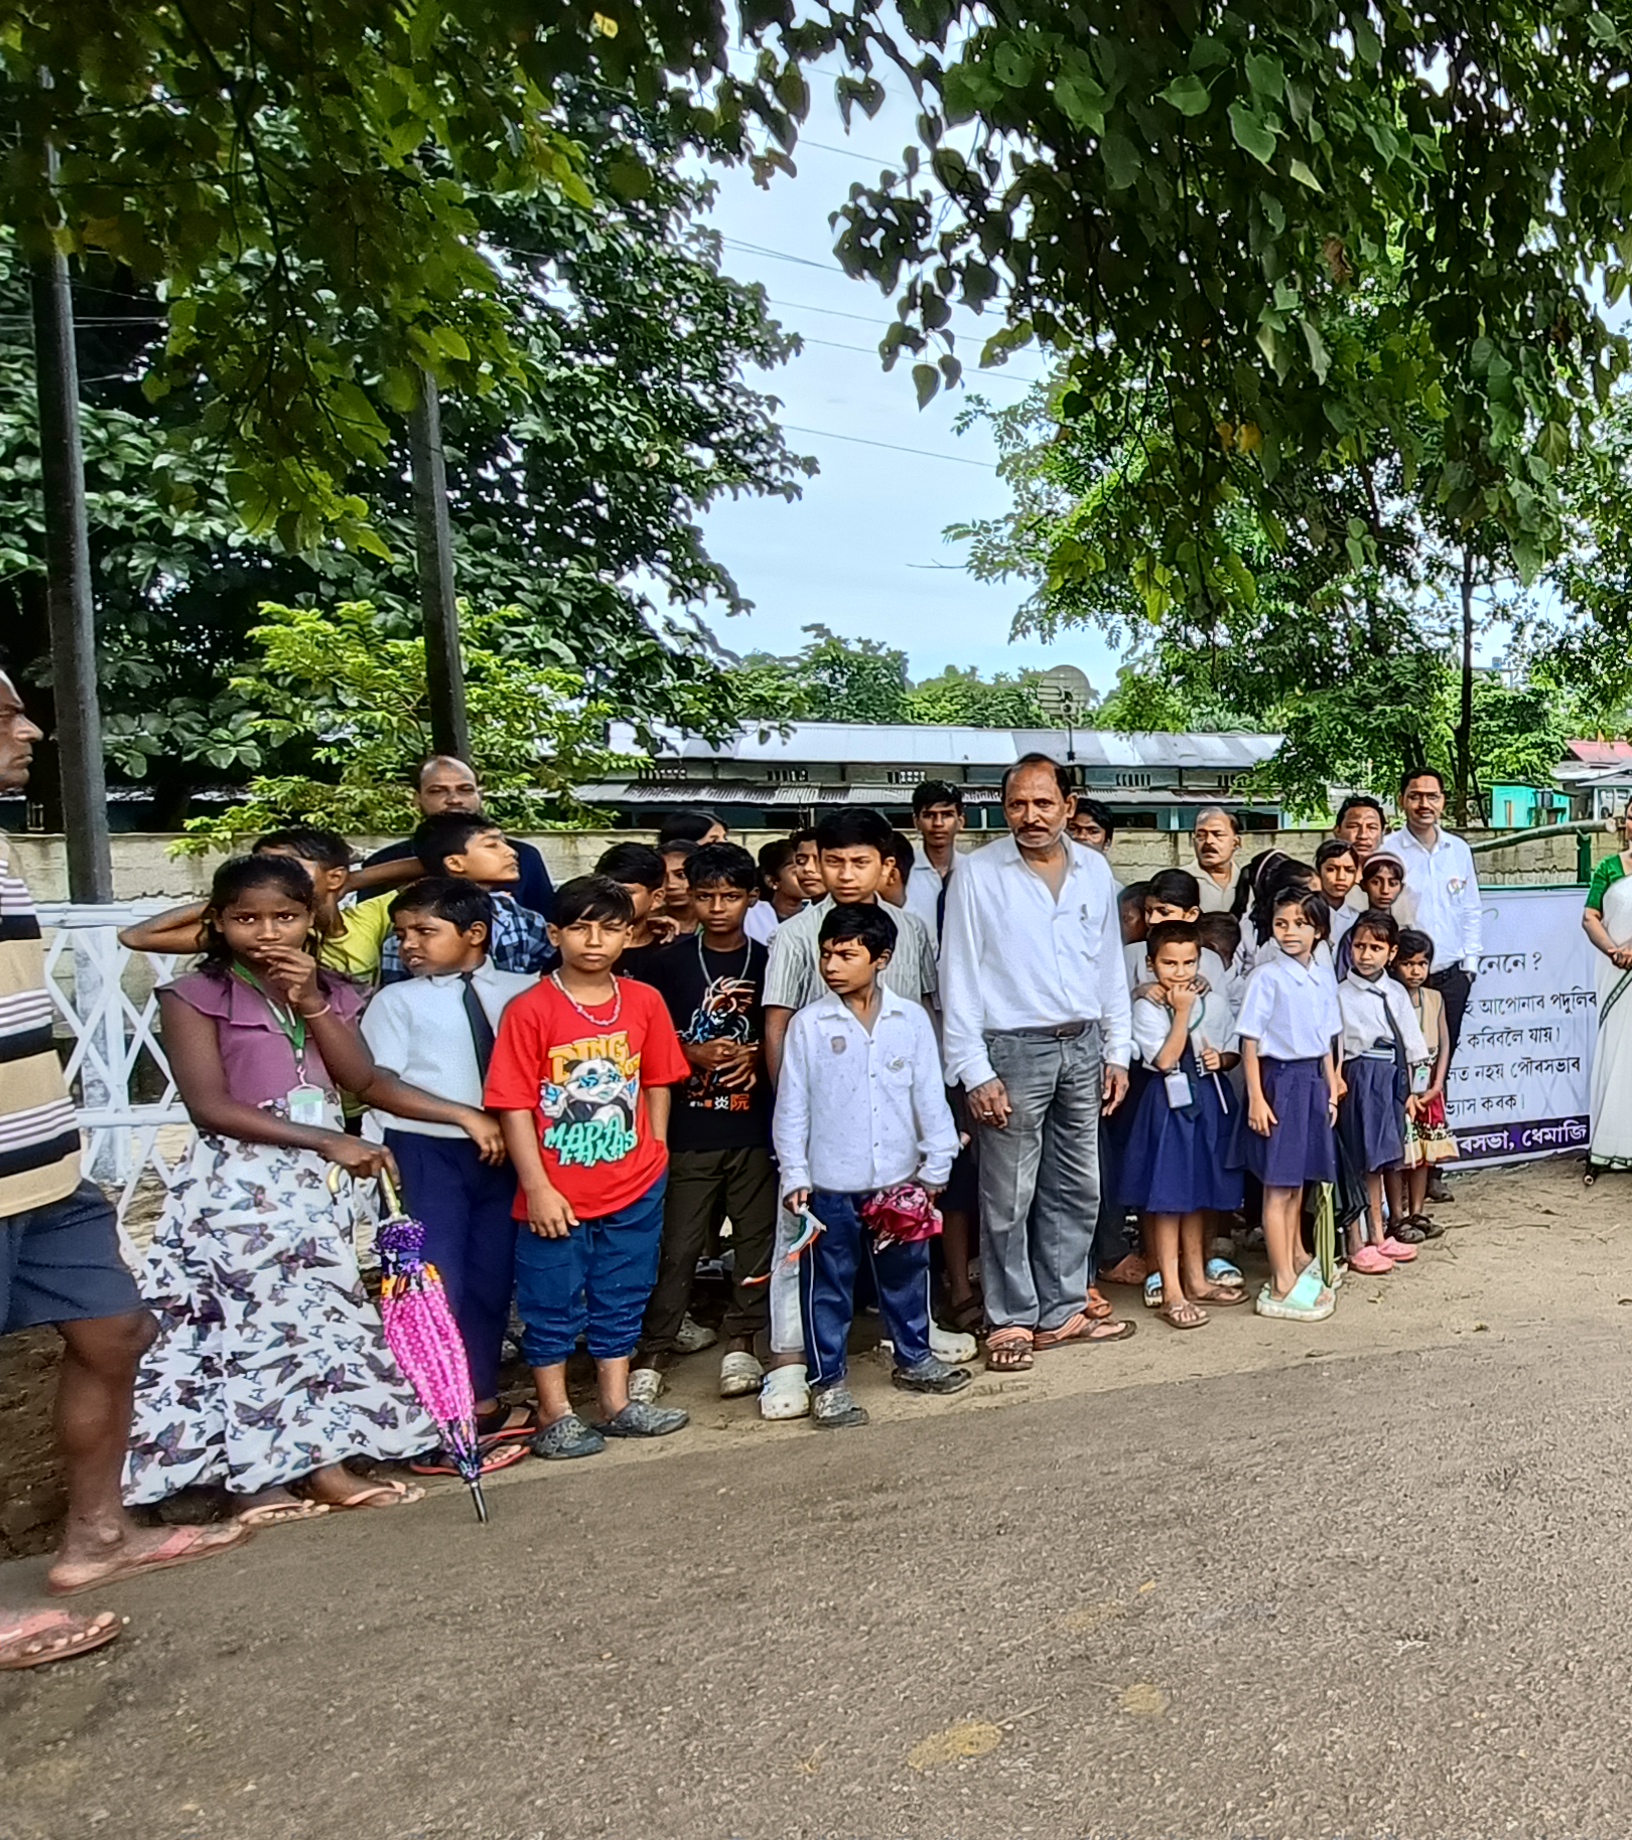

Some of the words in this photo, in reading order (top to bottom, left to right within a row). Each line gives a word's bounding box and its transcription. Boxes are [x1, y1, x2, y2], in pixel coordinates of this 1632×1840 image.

[1477, 953, 1526, 975] নেনে
[548, 1031, 628, 1084] DING
[1446, 1097, 1476, 1117] ভ্যাস
[1522, 1120, 1587, 1147] ধেমাজি
